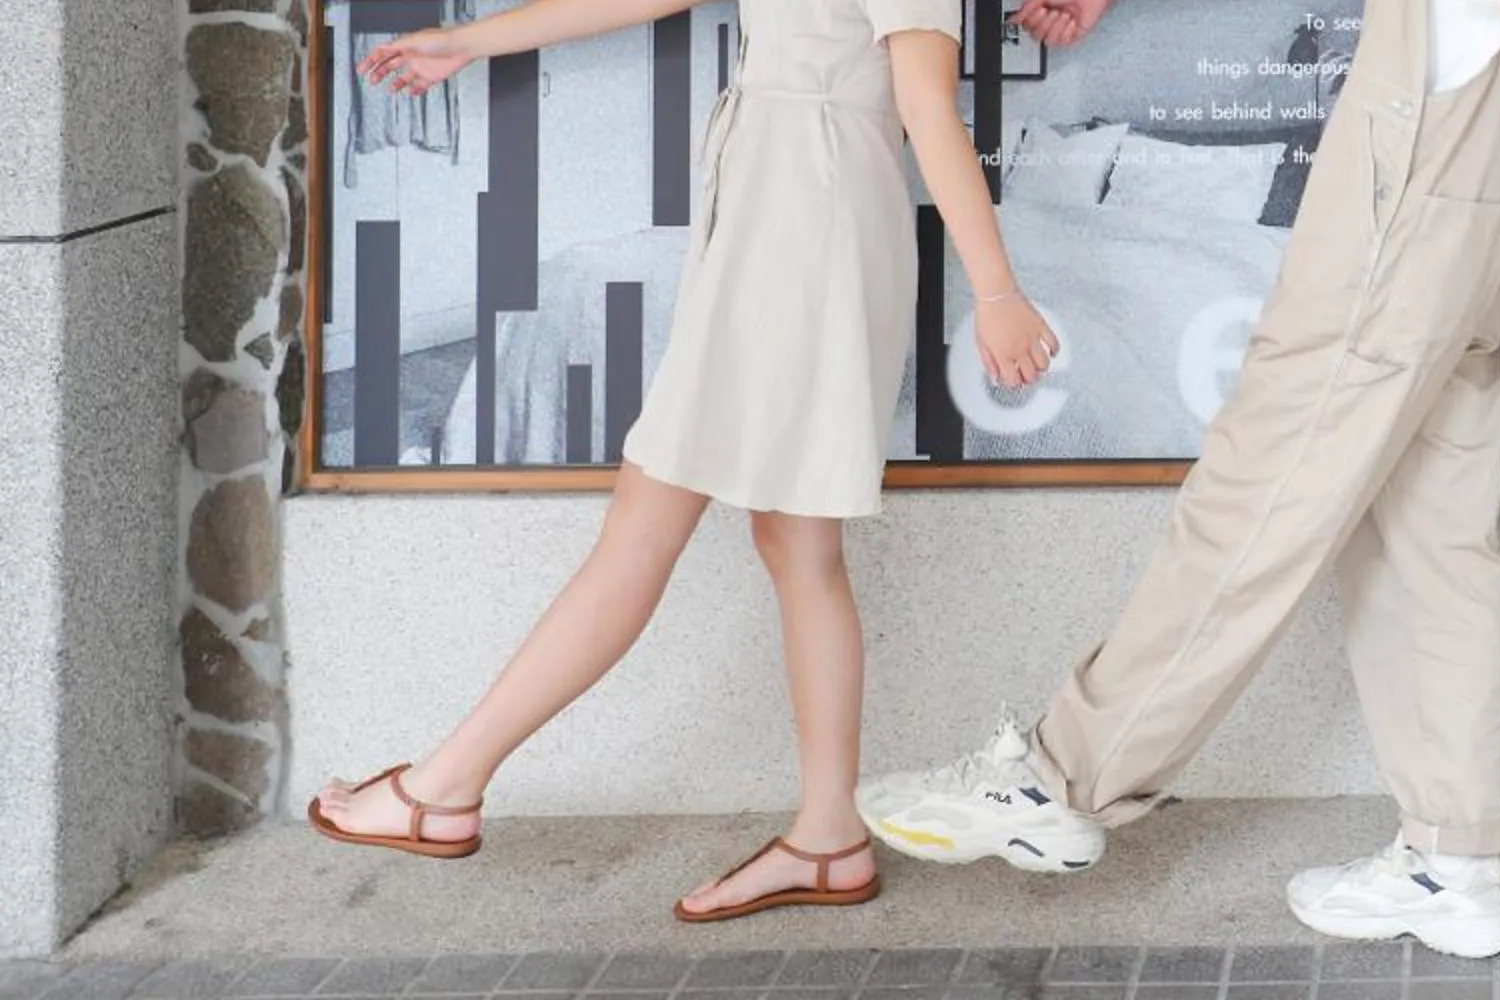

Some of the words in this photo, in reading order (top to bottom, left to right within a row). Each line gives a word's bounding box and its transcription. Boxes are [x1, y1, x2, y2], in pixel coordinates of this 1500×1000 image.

[1304, 13, 1325, 30] To
[1333, 17, 1362, 31] see
[1197, 57, 1250, 79] things
[1257, 56, 1352, 79] dangerous
[1149, 104, 1167, 121] to
[1175, 106, 1203, 121] see
[1211, 101, 1272, 120] behind
